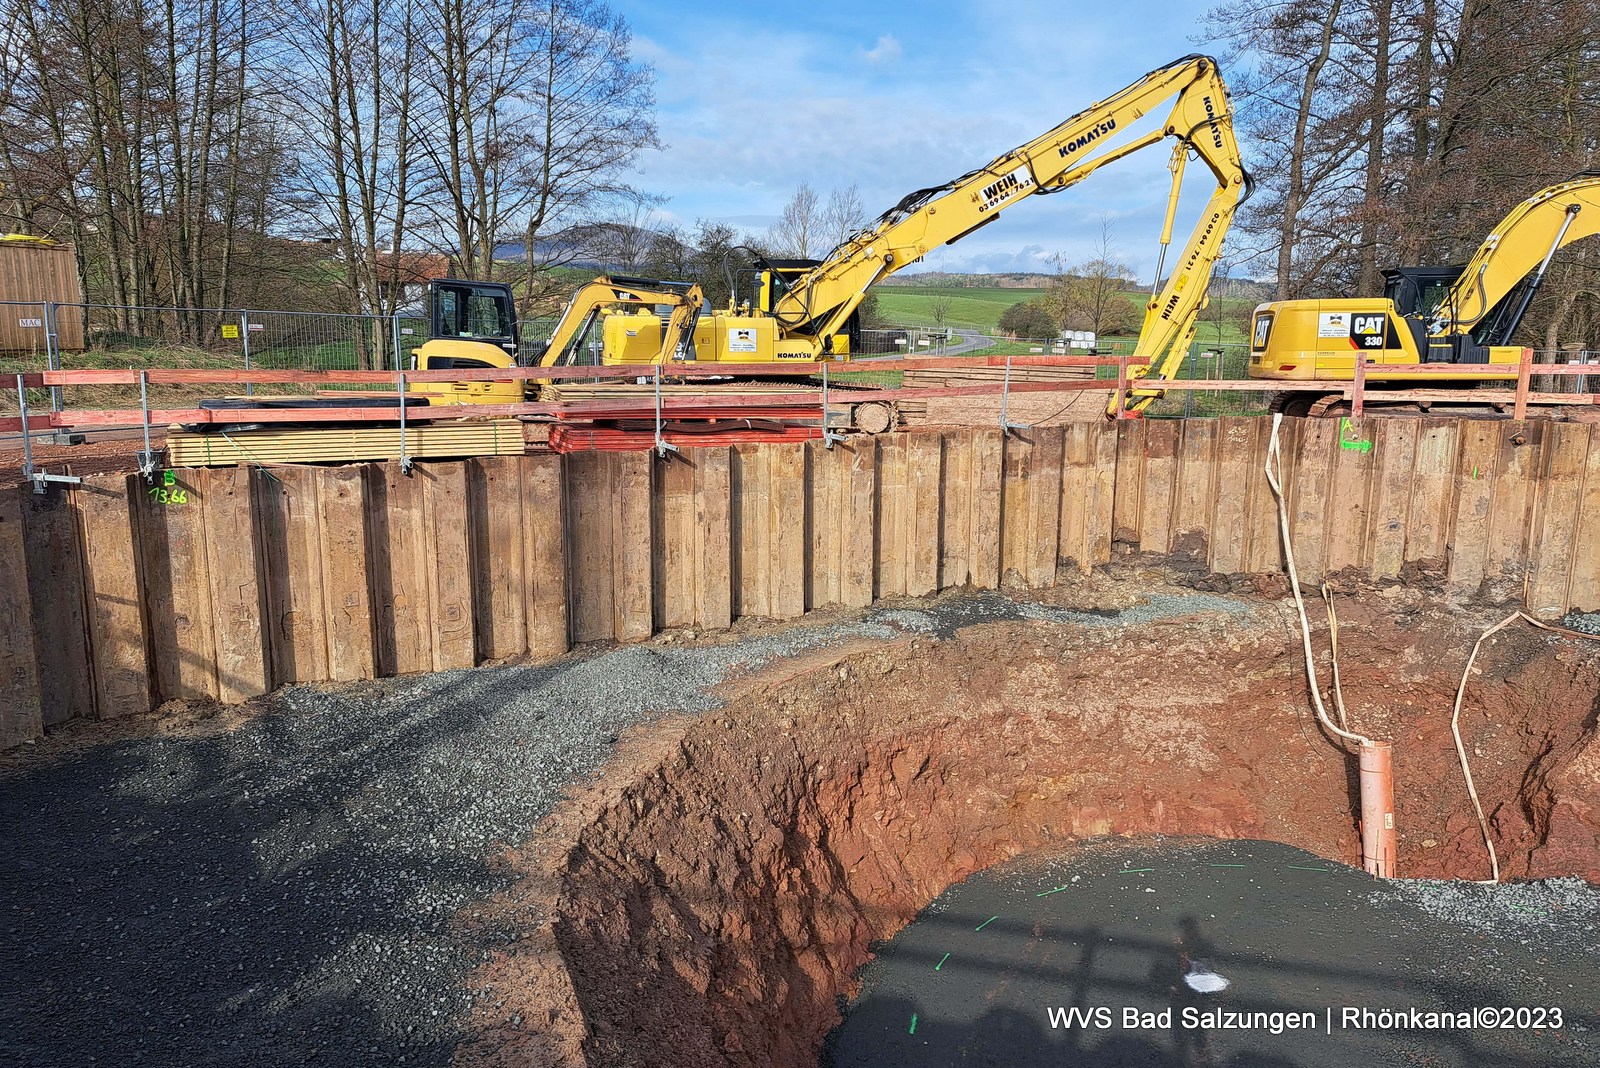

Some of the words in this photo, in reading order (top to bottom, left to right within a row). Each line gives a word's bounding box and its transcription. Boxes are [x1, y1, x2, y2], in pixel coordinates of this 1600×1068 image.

[1203, 96, 1222, 148] KOMATSU
[1058, 118, 1116, 158] KOMATSU
[983, 173, 1018, 200] WEIH
[619, 292, 630, 300] CAT
[1161, 295, 1180, 320] WEIH
[1254, 320, 1270, 347] CAT
[1354, 316, 1384, 334] CAT
[1364, 336, 1382, 346] 330
